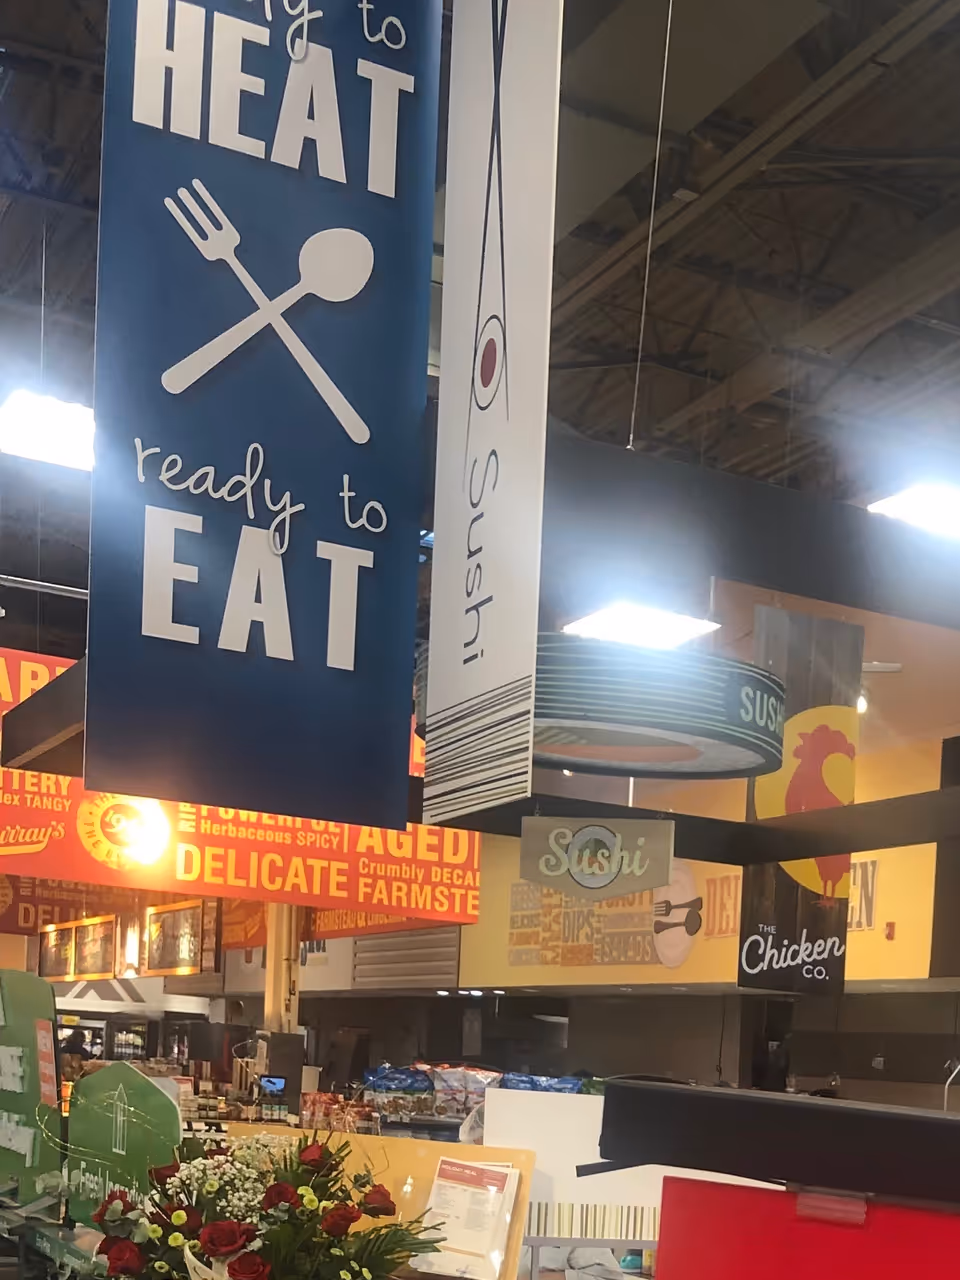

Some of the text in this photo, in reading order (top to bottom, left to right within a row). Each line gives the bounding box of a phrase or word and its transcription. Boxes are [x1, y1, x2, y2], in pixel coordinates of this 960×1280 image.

[358, 0, 407, 49] to
[132, 0, 415, 199] HEAT
[134, 437, 305, 556] ready
[340, 473, 389, 533] to
[462, 448, 499, 666] Sushi
[141, 504, 375, 672] EAT
[24, 793, 72, 813] TANGY
[200, 818, 340, 850] Herbaceous SPICY
[356, 822, 470, 865] AGED
[539, 828, 650, 877] Sushi
[175, 842, 350, 898] DELICATE
[358, 857, 425, 884] Crumbly
[741, 928, 846, 975] Chicken
[758, 923, 777, 934] THE
[802, 964, 830, 980] CO.
